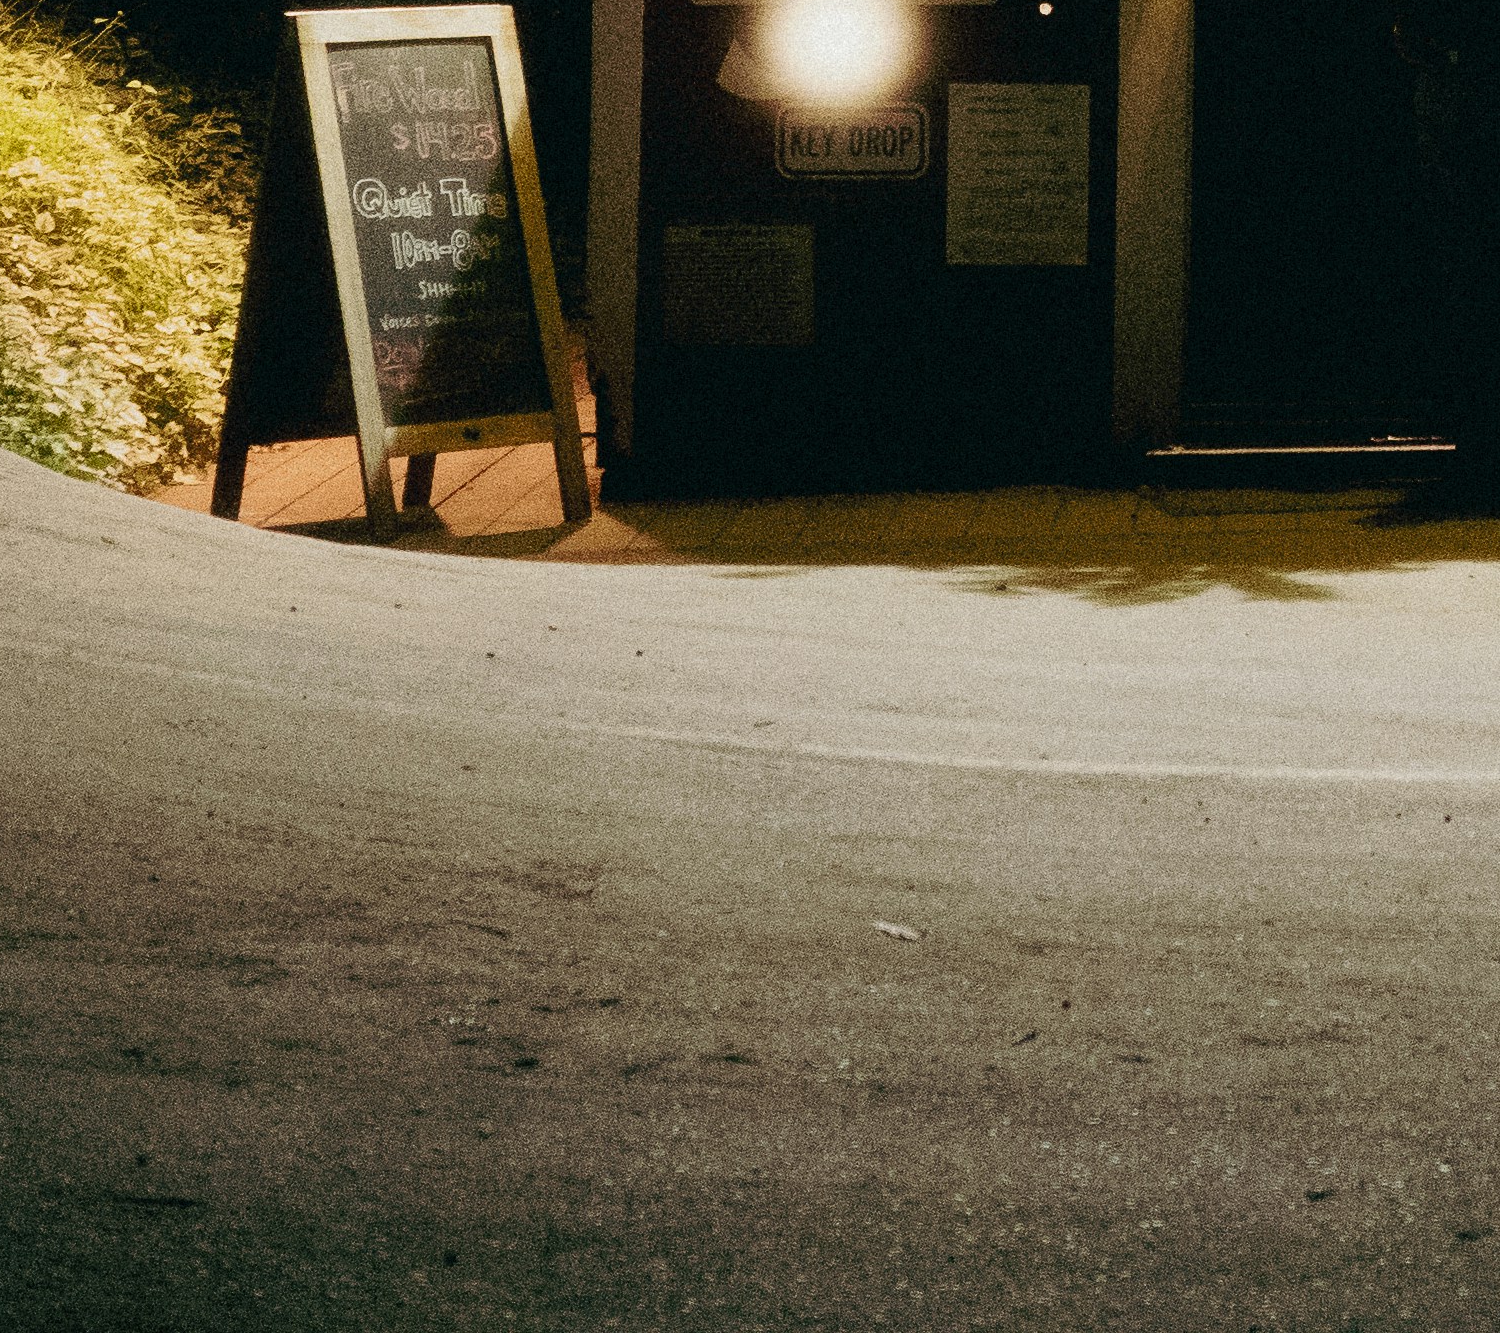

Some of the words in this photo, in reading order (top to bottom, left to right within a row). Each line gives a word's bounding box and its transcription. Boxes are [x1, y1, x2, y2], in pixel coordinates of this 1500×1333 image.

[788, 126, 834, 158] KEY
[848, 125, 914, 157] DROP
[352, 177, 431, 219] Quiet
[439, 177, 508, 218] Time
